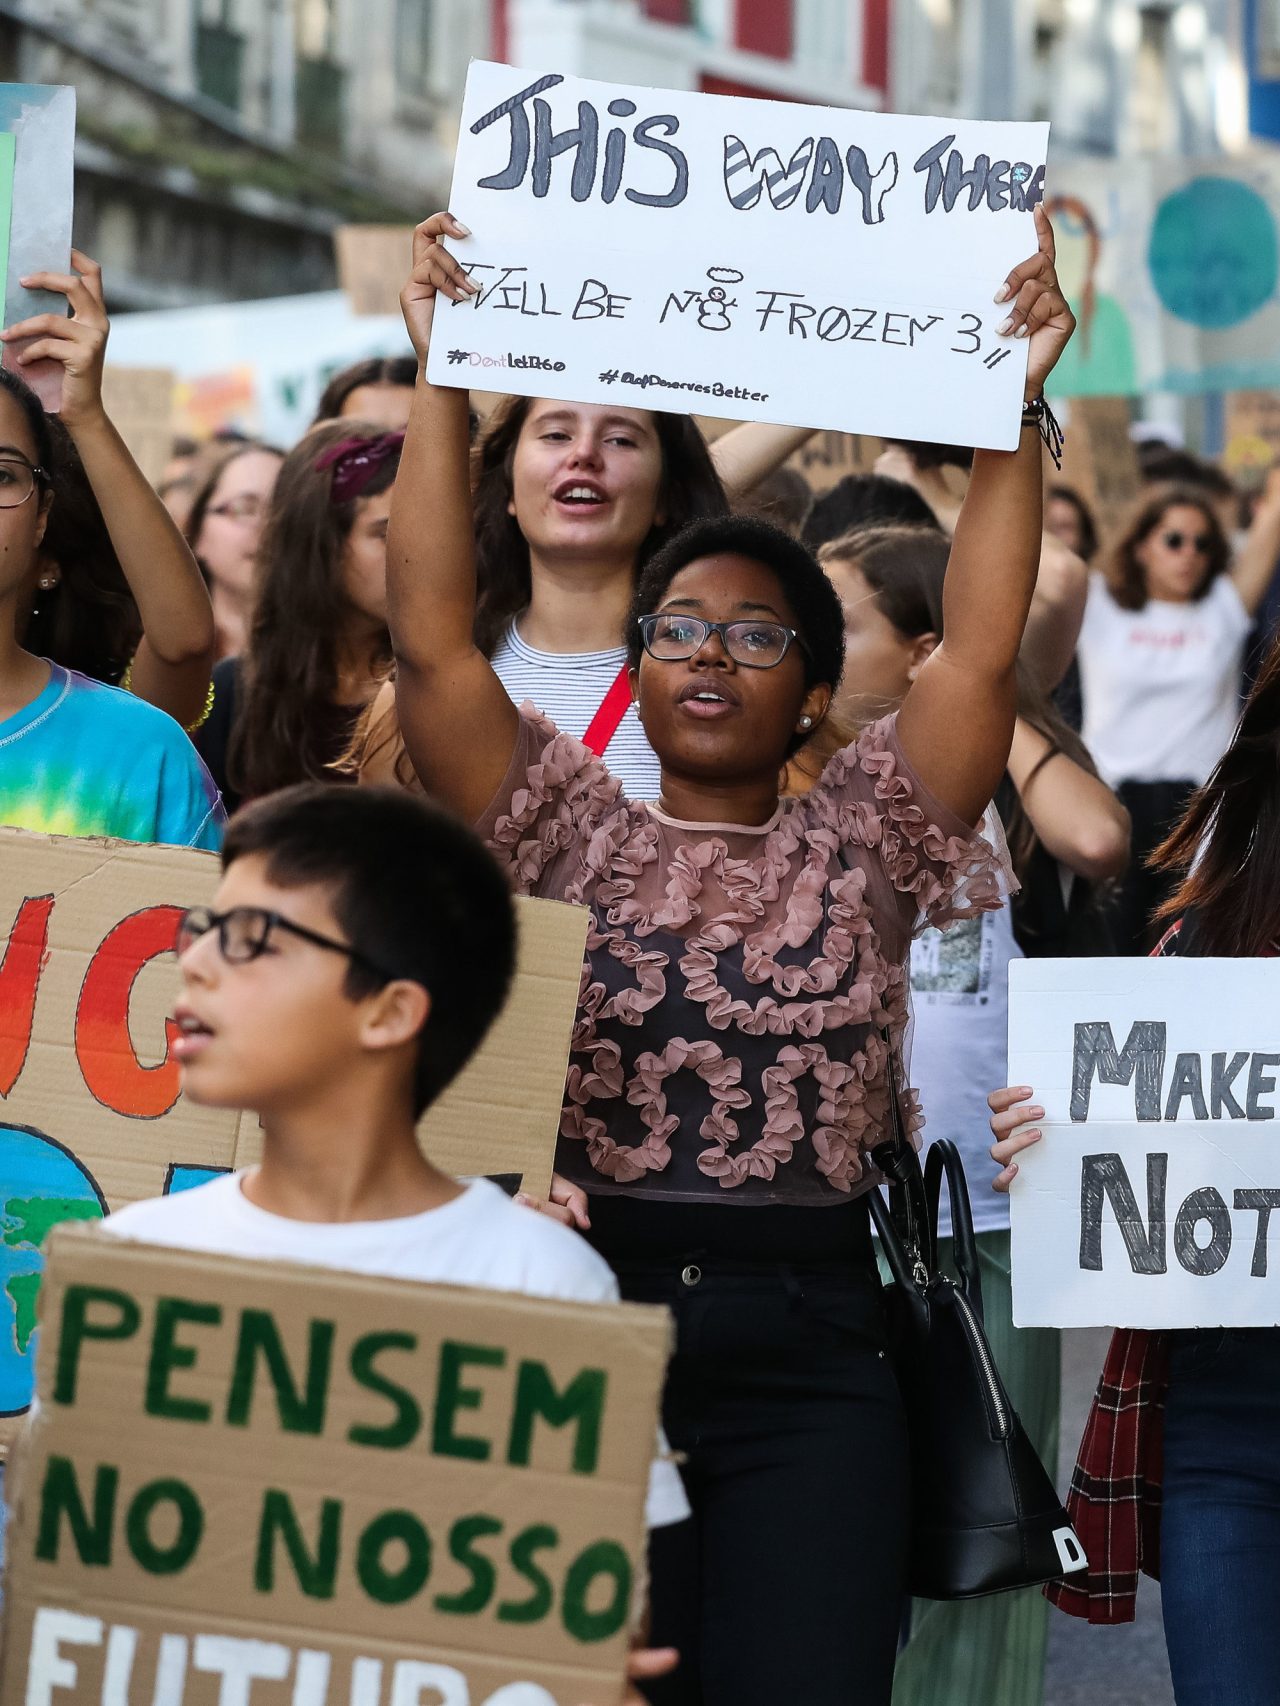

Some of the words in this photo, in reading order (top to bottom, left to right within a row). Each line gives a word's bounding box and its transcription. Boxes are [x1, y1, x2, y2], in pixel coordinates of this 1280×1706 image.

[723, 134, 899, 225] WAY
[572, 279, 632, 320] BE
[52, 1284, 609, 1475] PENSEM
[34, 1455, 206, 1576] NO
[254, 1488, 633, 1645] NOSSO
[25, 1606, 560, 1706] FUT
